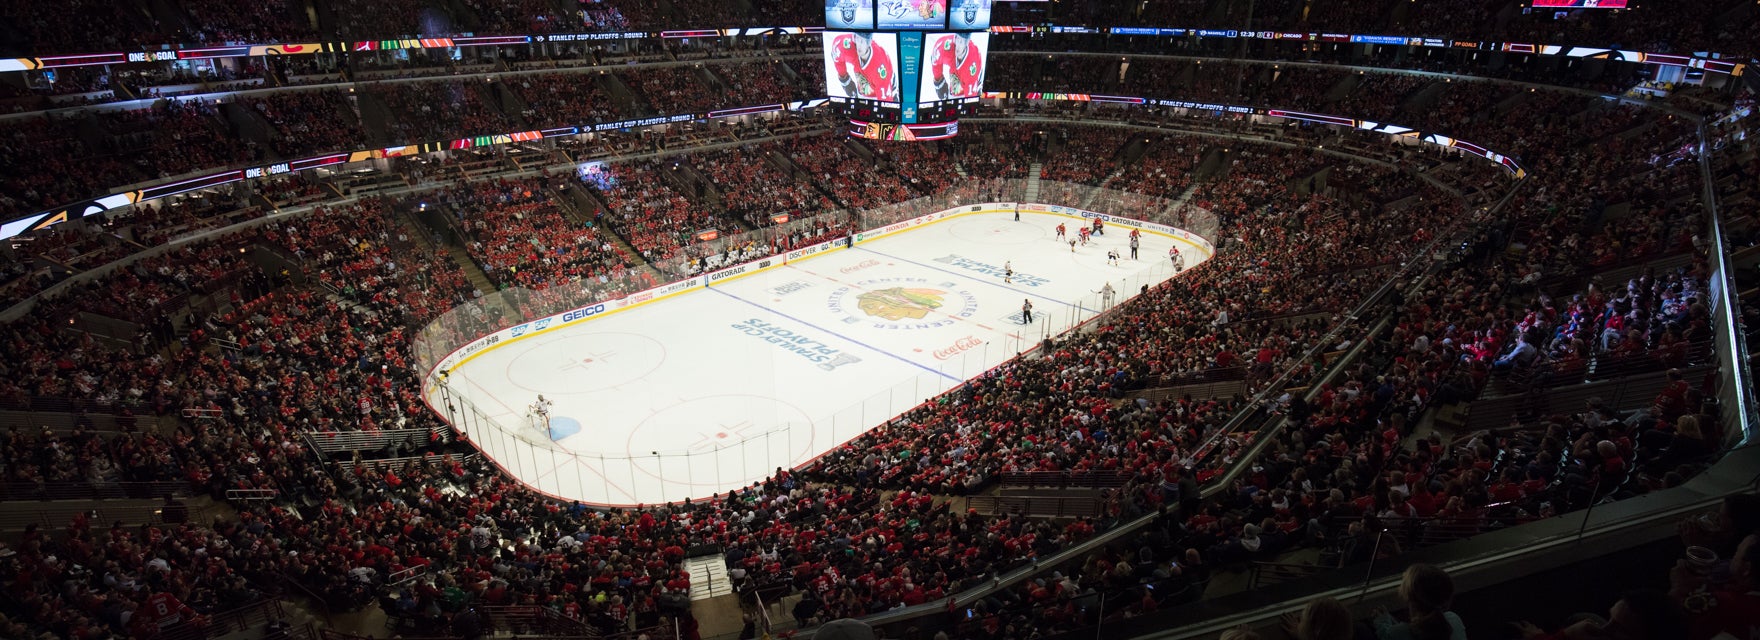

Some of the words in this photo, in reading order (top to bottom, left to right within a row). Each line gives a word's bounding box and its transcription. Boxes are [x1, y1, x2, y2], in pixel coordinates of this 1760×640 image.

[548, 34, 576, 42] STANLEY
[128, 52, 145, 62] ONE
[156, 51, 177, 61] GOAL
[1195, 103, 1224, 111] PLAYOFFS
[595, 122, 623, 131] STANLEY
[623, 120, 637, 128] CUP
[637, 117, 666, 126] PLAYOFFS
[671, 114, 691, 122] ROUND
[246, 167, 261, 179] ONE
[271, 163, 290, 175] GOAL
[886, 222, 909, 233] HONDA
[1111, 217, 1143, 228] GATORADE
[1147, 224, 1169, 232] UNITED
[789, 247, 817, 260] DISCOVER
[711, 266, 746, 281] GATORADE
[827, 287, 849, 313] UNITED
[959, 290, 978, 318] UNITED
[562, 304, 605, 323] GEICO
[730, 323, 764, 336] CUP
[873, 319, 955, 330] CENTER
[742, 318, 839, 355] PLAYOFFS
[760, 335, 830, 363] STANLEY
[932, 335, 983, 361] Coca-Cola
